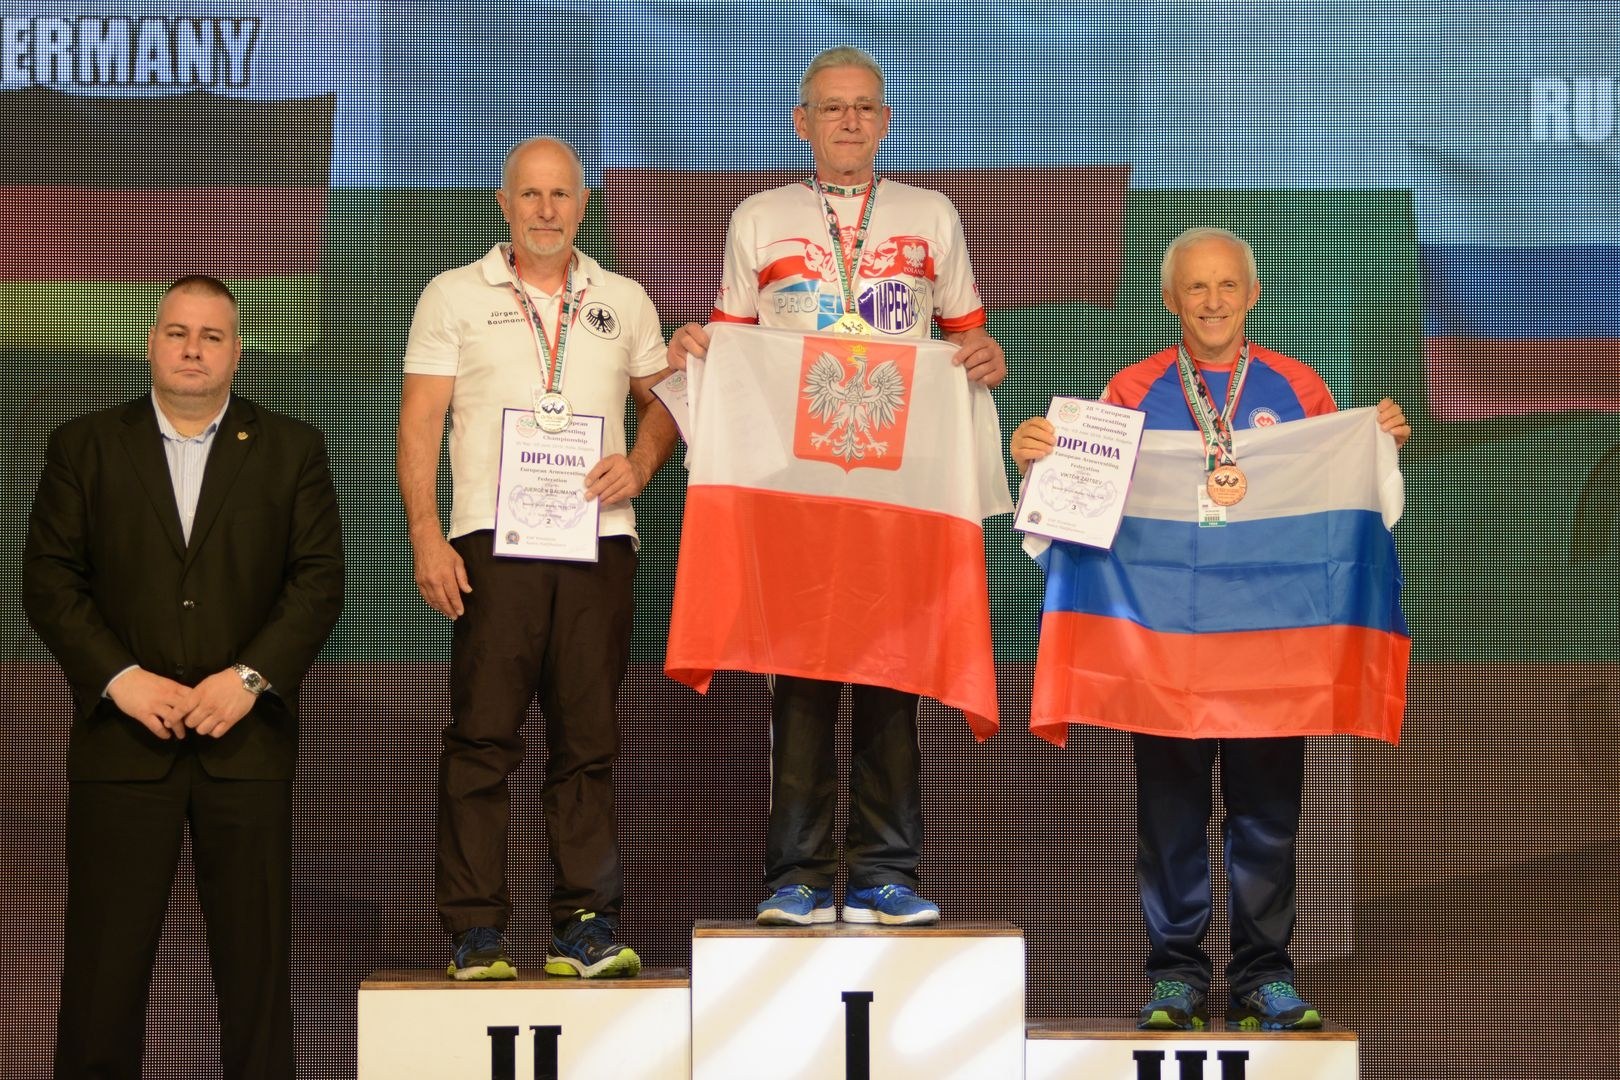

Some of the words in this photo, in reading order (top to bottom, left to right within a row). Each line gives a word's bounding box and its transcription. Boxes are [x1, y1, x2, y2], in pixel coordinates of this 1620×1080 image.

[1082, 422, 1128, 436] Championship
[1056, 435, 1121, 460] DIPLOMA
[520, 451, 586, 468] DIPLOMA
